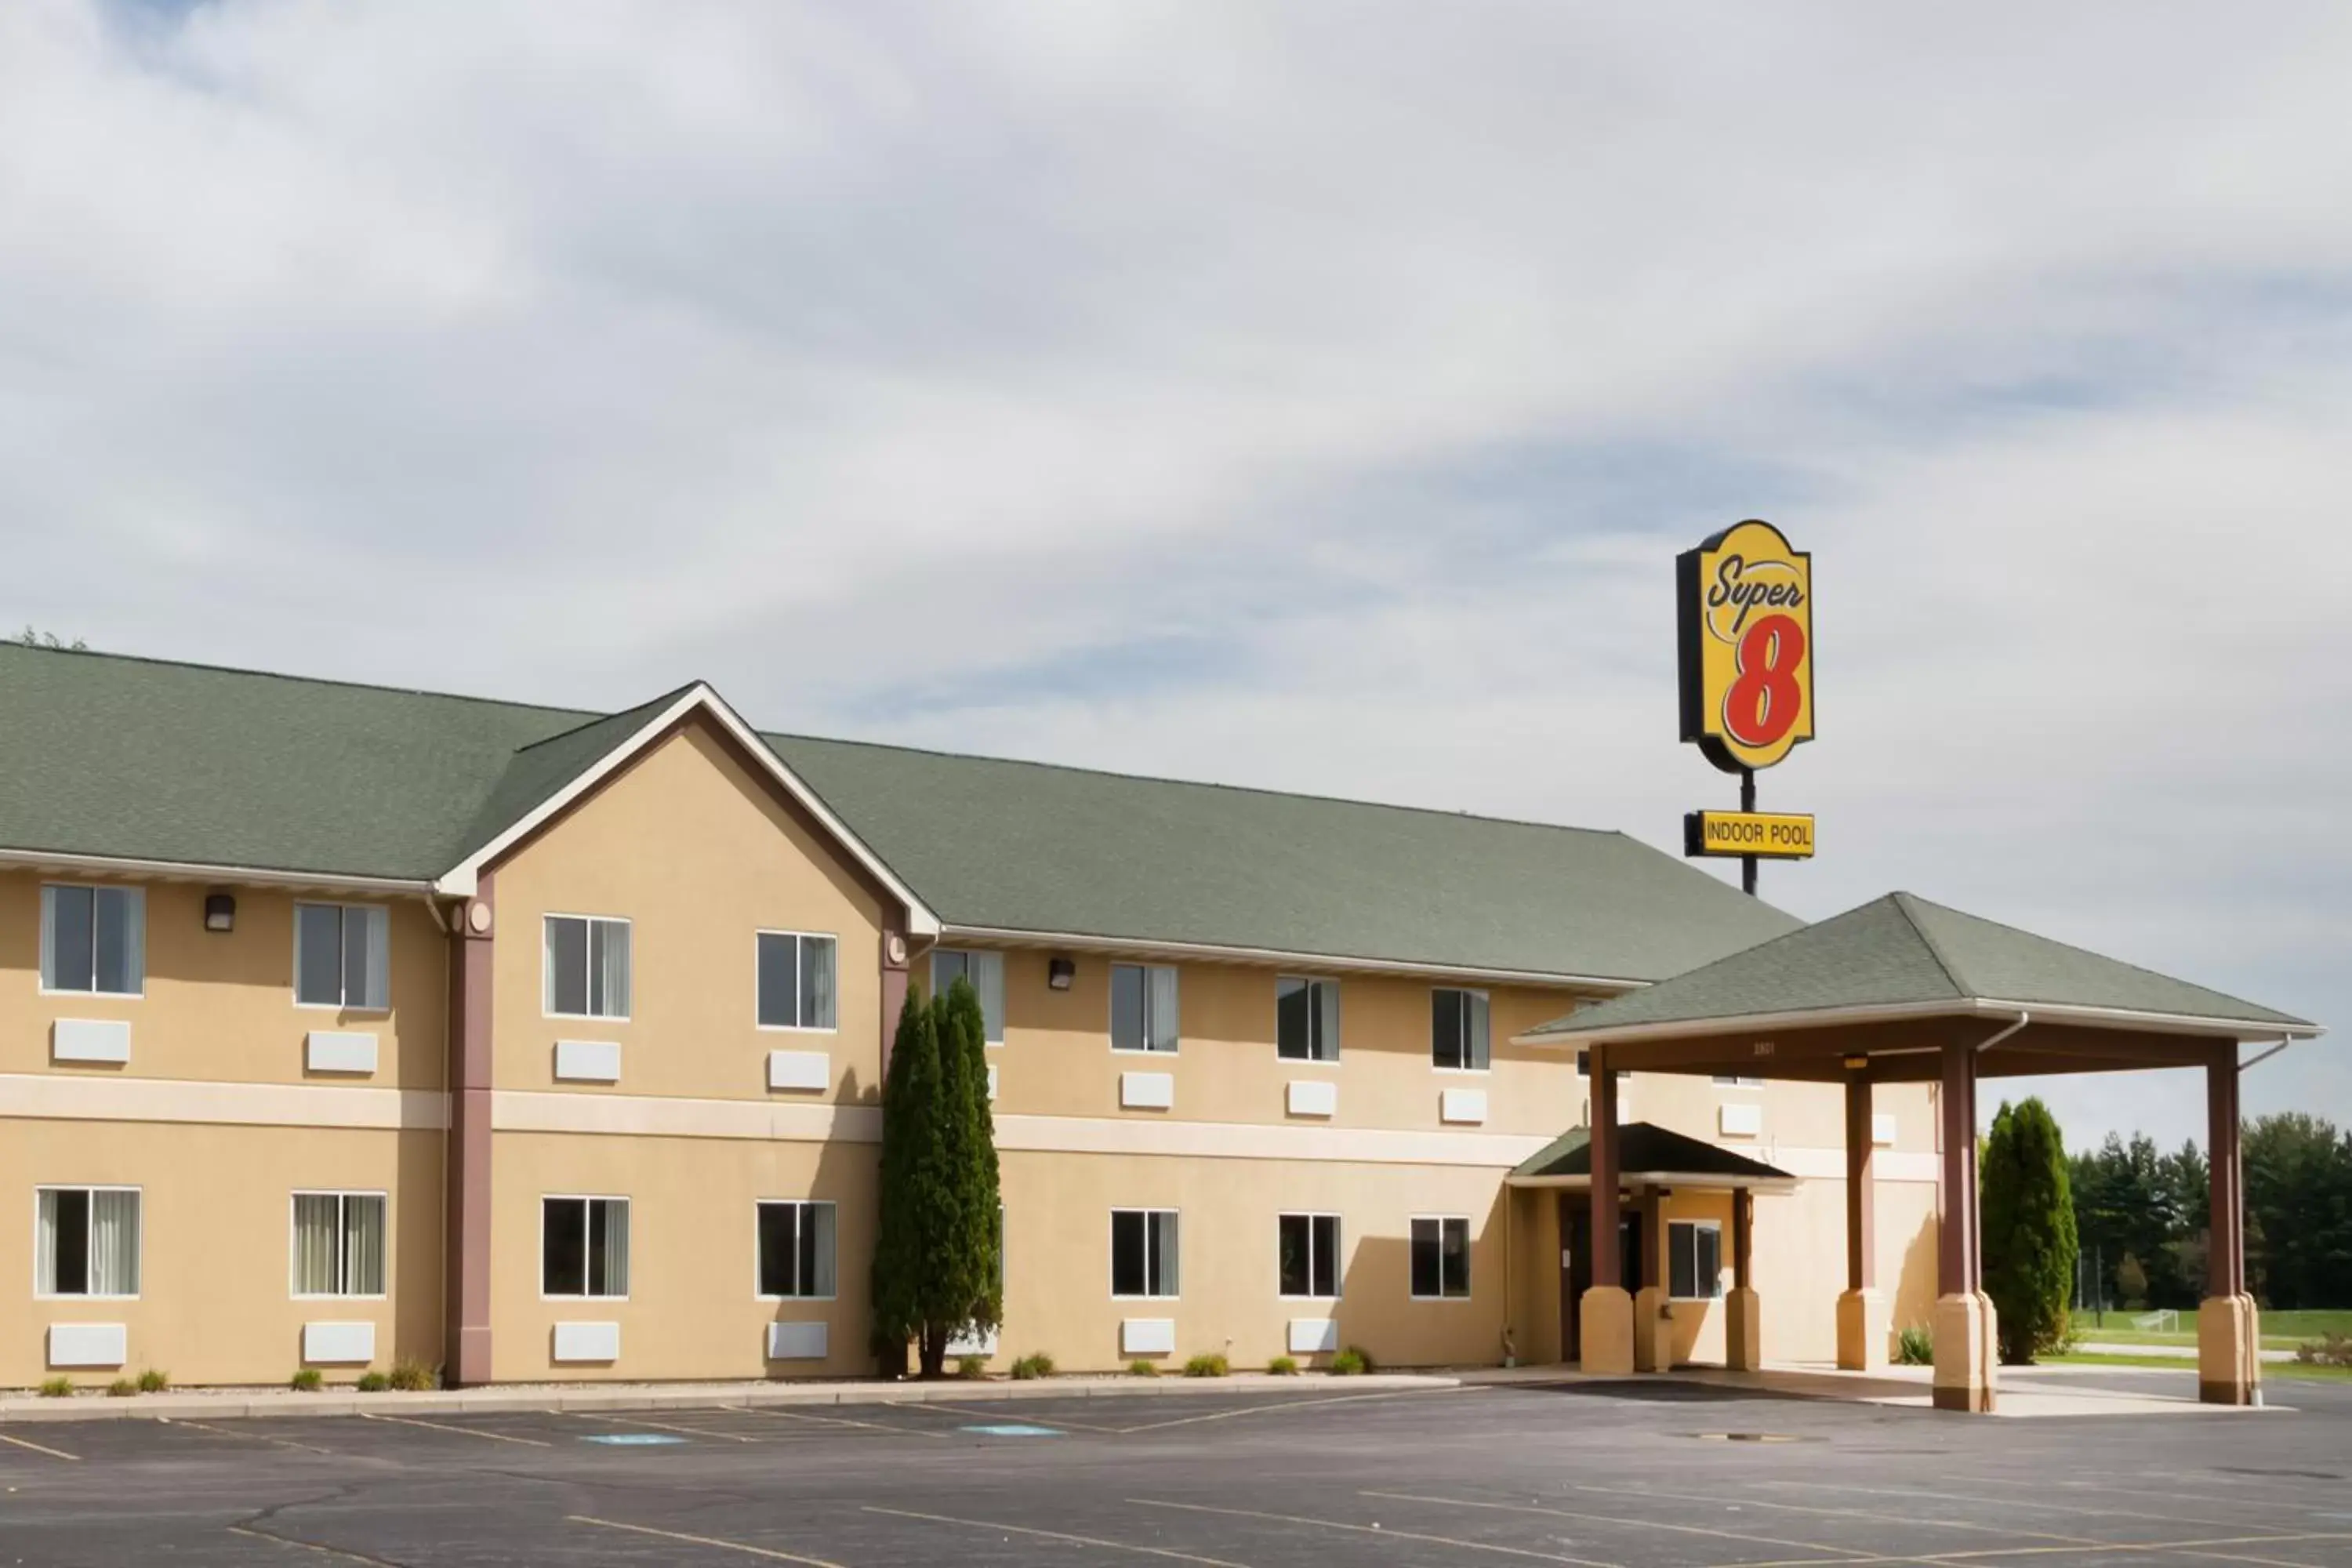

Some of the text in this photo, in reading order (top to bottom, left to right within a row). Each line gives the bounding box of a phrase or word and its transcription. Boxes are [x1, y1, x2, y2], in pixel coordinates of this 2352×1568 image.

[1708, 554, 1805, 634] Super
[1722, 614, 1805, 746] 8
[1707, 821, 1811, 845] INDOOR POOL
